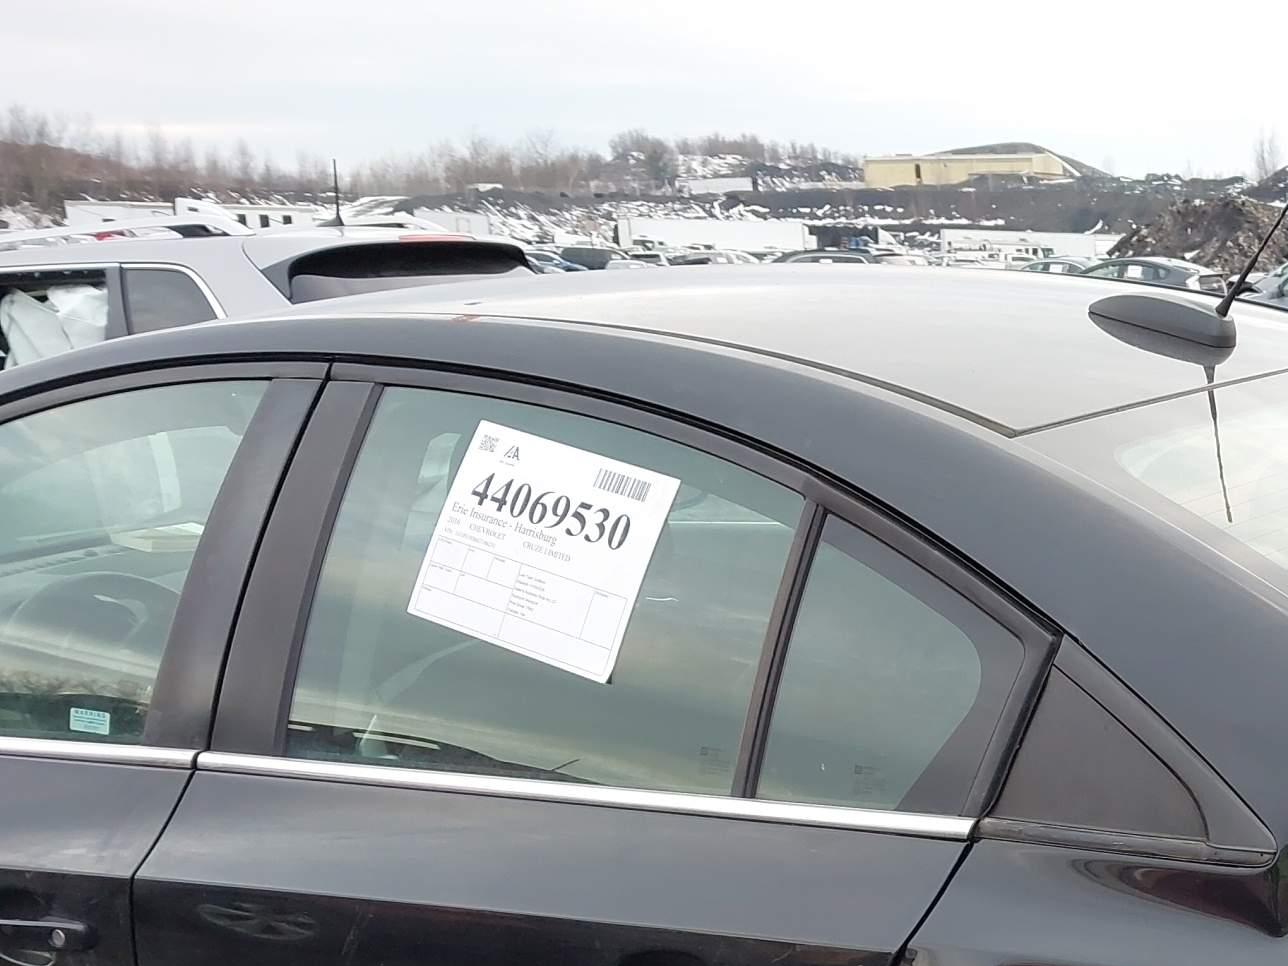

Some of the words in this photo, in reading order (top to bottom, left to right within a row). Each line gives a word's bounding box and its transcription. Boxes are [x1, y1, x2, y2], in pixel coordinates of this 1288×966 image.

[452, 501, 469, 516] Erie
[470, 507, 508, 528] Insurance
[514, 521, 558, 547] Harrisburg
[471, 472, 632, 551] 44069530
